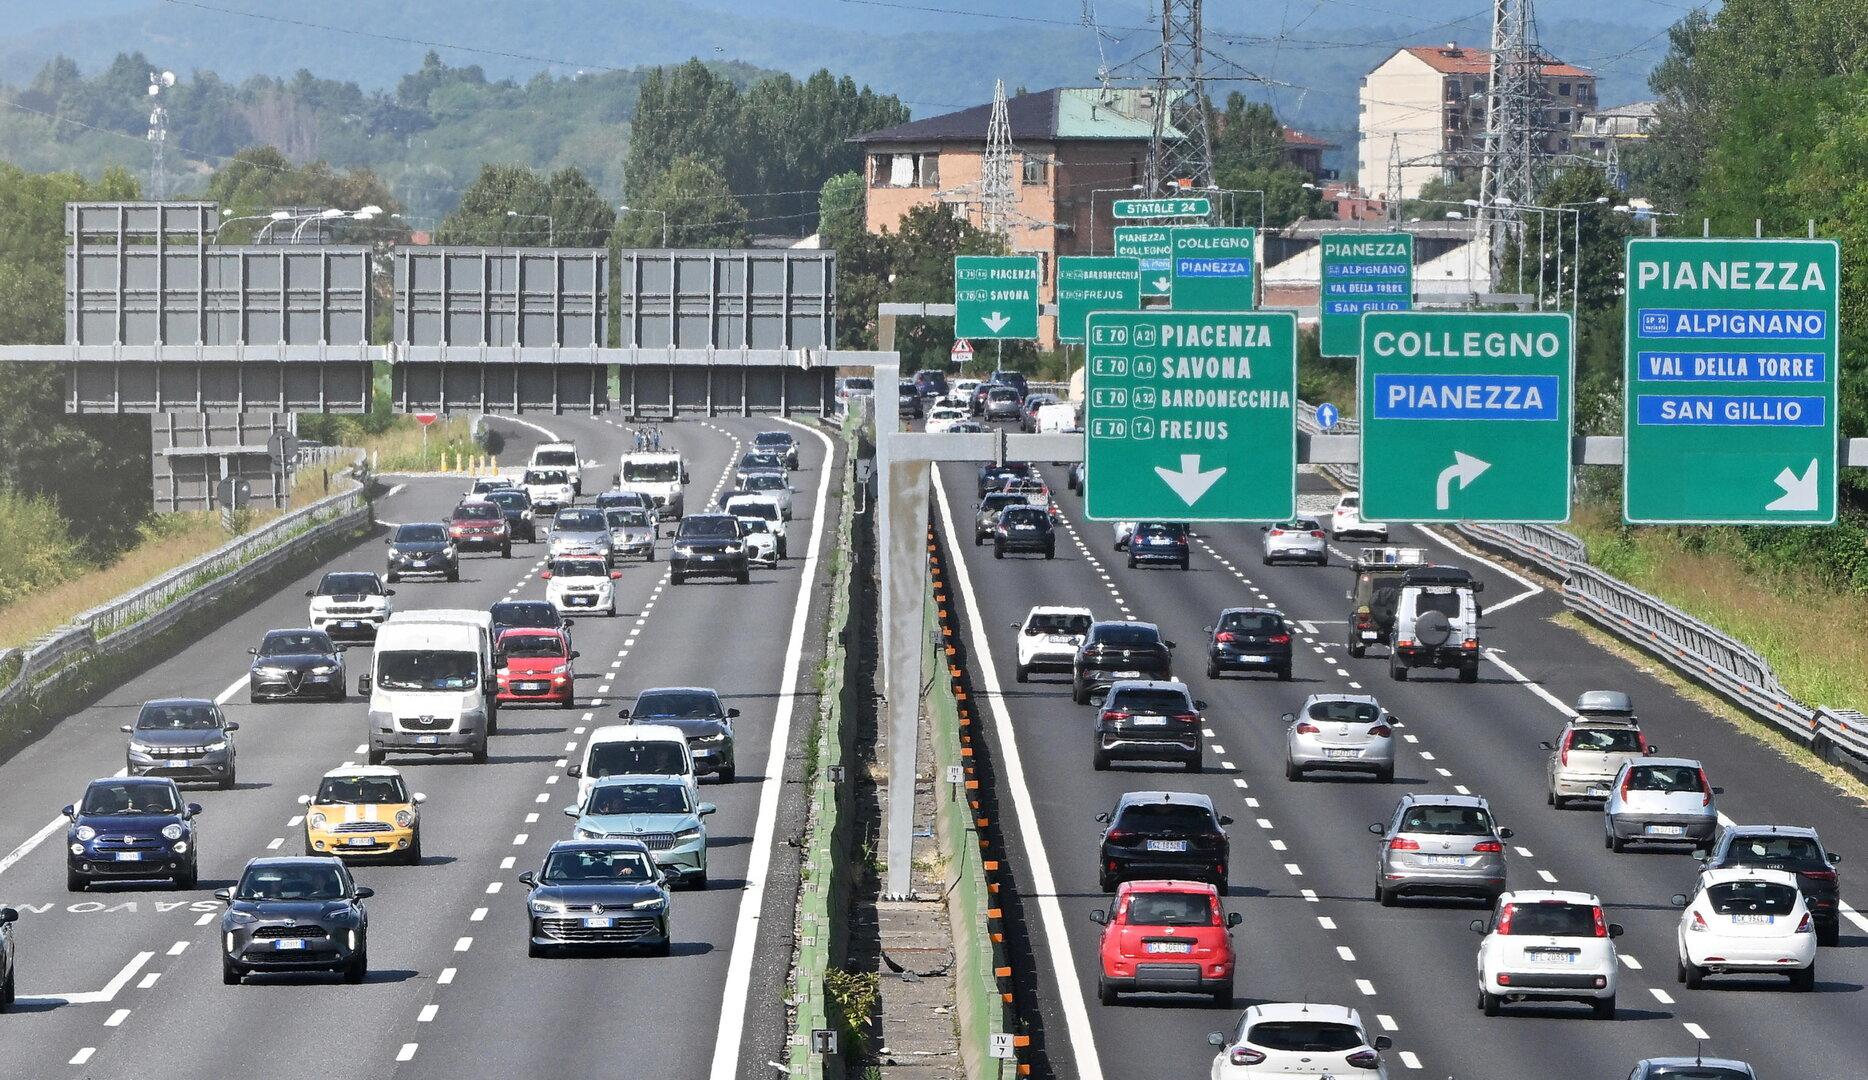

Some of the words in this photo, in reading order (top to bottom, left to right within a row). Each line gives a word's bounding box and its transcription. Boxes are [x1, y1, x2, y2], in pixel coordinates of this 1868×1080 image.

[1127, 204, 1174, 214] STATALE
[1181, 203, 1196, 213] 24
[1119, 233, 1166, 242] PIANEZZA
[1177, 238, 1249, 249] COLLEGNO
[1119, 246, 1171, 255] COLLEGNO
[1325, 243, 1407, 257] PIANEZZA
[1181, 262, 1244, 273] PIANEZZA
[1342, 265, 1406, 275] ALPIGNANO
[990, 269, 1036, 280] PIACENZA
[1638, 261, 1826, 291] PIANEZZA
[1330, 284, 1346, 293] VAL
[1349, 284, 1373, 293] DELLA
[990, 290, 1029, 301] SAVONA
[1084, 291, 1123, 300] FREJUS
[1334, 303, 1358, 312] SAN
[1675, 314, 1822, 335] ALPIGNANO
[1096, 330, 1103, 342] E
[1110, 330, 1126, 342] 70
[1161, 325, 1272, 347] PIACENZA
[1373, 331, 1560, 358] COLLEGNO
[1096, 361, 1103, 373] E
[1110, 361, 1126, 373] 70
[1161, 356, 1251, 379] SAVONA
[1650, 357, 1683, 376] VAL
[1694, 357, 1749, 377] DELLA
[1757, 358, 1815, 377] TORRE
[1096, 392, 1102, 404] E
[1110, 392, 1125, 404] 70
[1161, 389, 1290, 409] BARDONECCHIA
[1388, 384, 1544, 410] PIANEZZA
[1660, 401, 1714, 420] SAN
[1724, 401, 1802, 421] GILLIO
[1095, 423, 1102, 435] E
[1109, 423, 1125, 435] 70
[1160, 420, 1229, 440] FREJUS
[0, 901, 223, 914] SAVON
[996, 1035, 1007, 1045] IV
[998, 1047, 1006, 1056] 7
